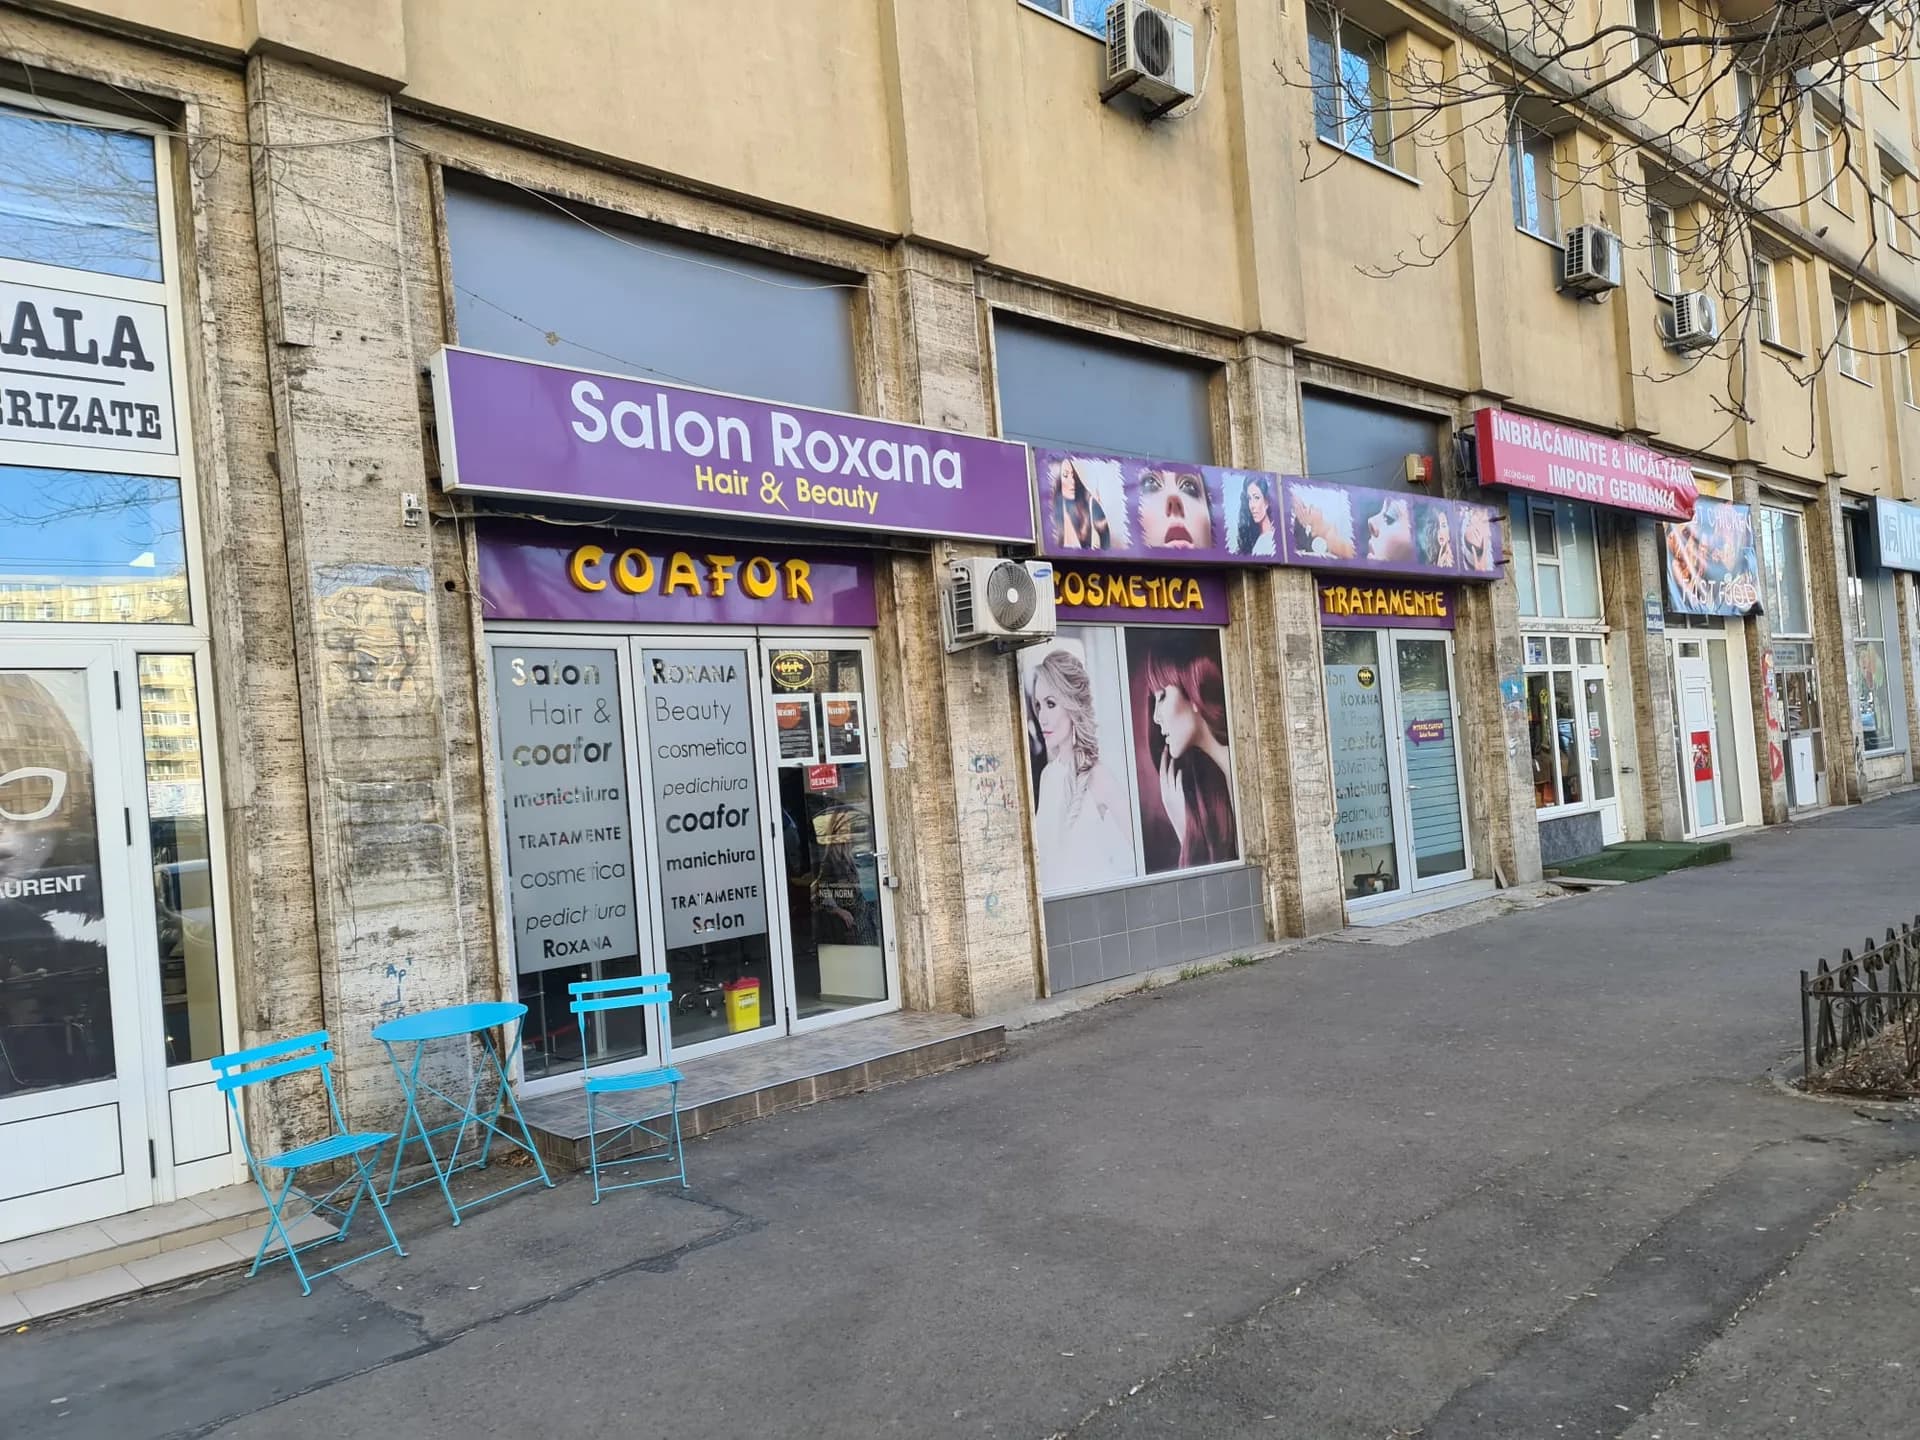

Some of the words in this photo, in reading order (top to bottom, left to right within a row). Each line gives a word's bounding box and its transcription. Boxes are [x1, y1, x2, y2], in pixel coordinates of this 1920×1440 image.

[0, 301, 155, 372] ALA
[0, 388, 162, 440] RIZATE
[570, 380, 752, 463] Salon
[771, 412, 963, 490] Roxana
[1611, 447, 1621, 469] &
[694, 465, 749, 498] Hair
[759, 470, 790, 511] &
[796, 476, 879, 515] Beauty
[1548, 463, 1604, 497] IMPORT
[1610, 477, 1678, 511] GERMANIA
[569, 544, 814, 603] COAFOR
[1323, 585, 1448, 617] TRATAMENTE
[1681, 578, 1716, 607] FAST
[1719, 580, 1757, 606] FOOD
[511, 657, 600, 687] Salon
[529, 698, 583, 725] Hair
[593, 698, 611, 723] &
[655, 696, 732, 725] Beauty
[512, 736, 613, 767] coafor
[657, 737, 748, 759] cosmetica
[513, 785, 619, 808] manichiura
[662, 775, 749, 800] pedichiura
[665, 803, 750, 834] coafor
[518, 826, 621, 849] TRATAMENTE
[666, 848, 756, 872] manichiura
[671, 885, 758, 910] TRATAMENTE
[692, 912, 745, 935] Salon
